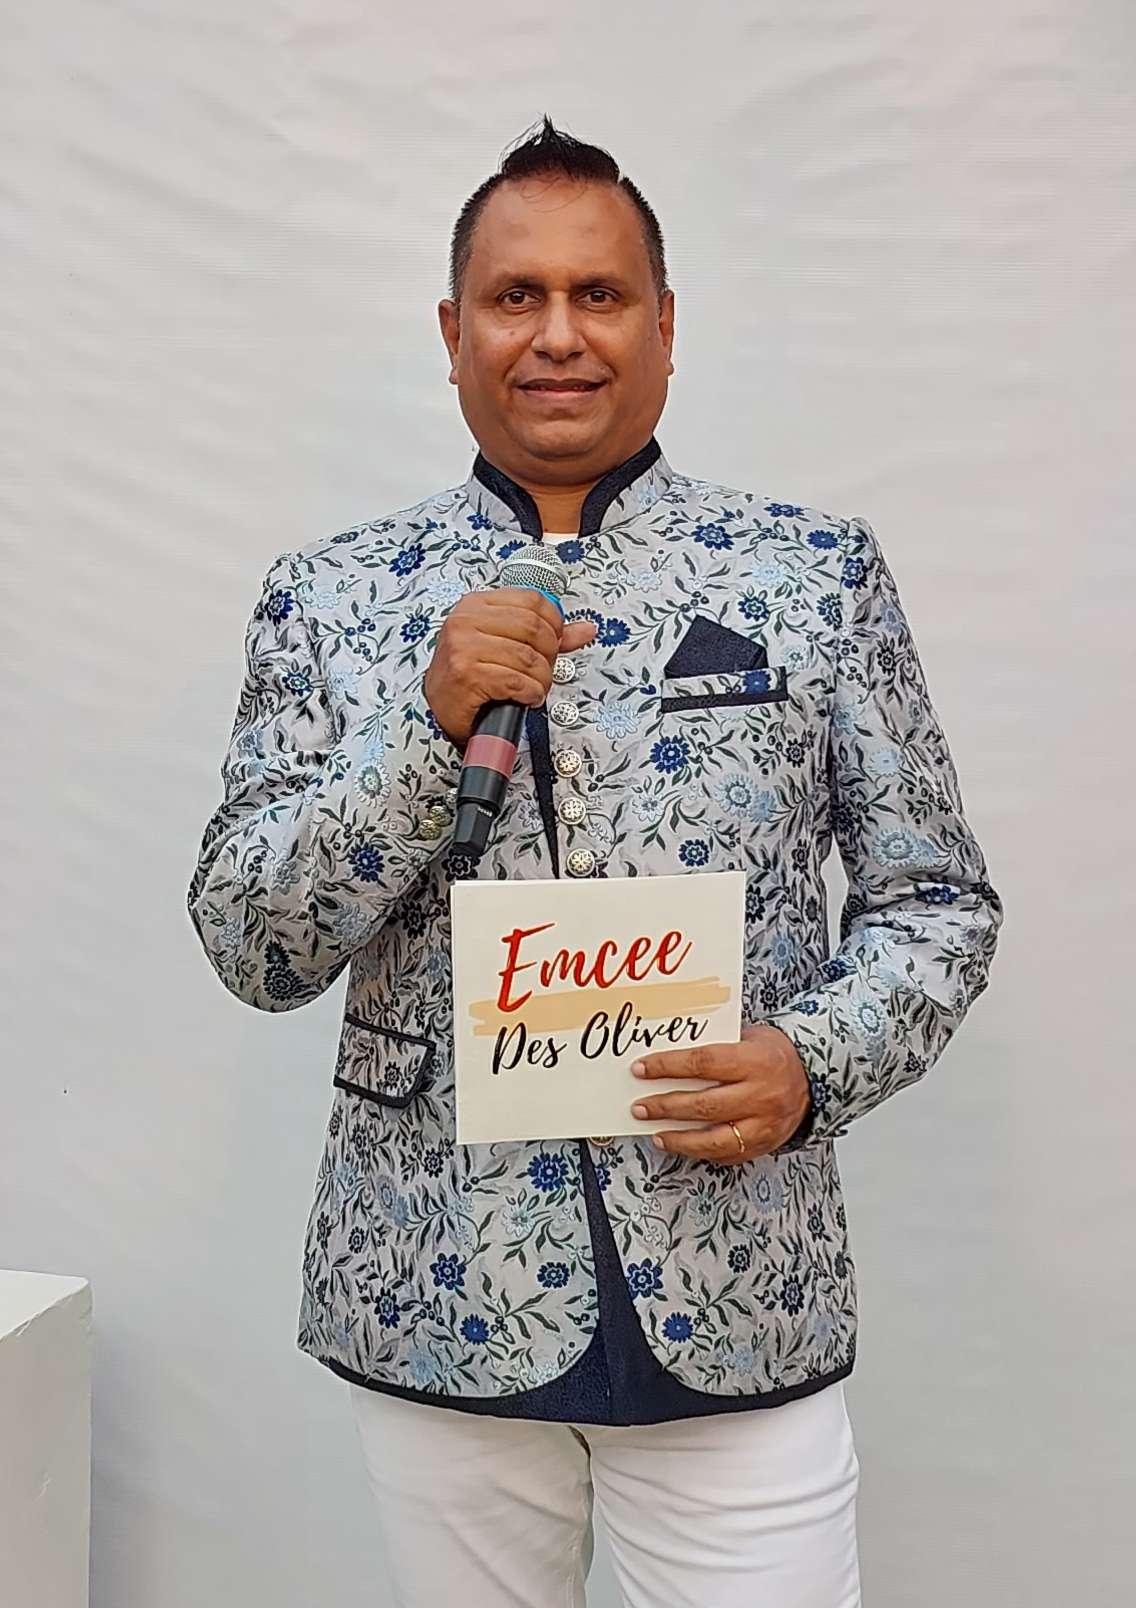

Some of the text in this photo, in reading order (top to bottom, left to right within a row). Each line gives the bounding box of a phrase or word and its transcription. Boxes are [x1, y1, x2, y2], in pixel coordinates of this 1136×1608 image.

[497, 923, 693, 1013] Emcee
[492, 1001, 709, 1075] Des Oliver
